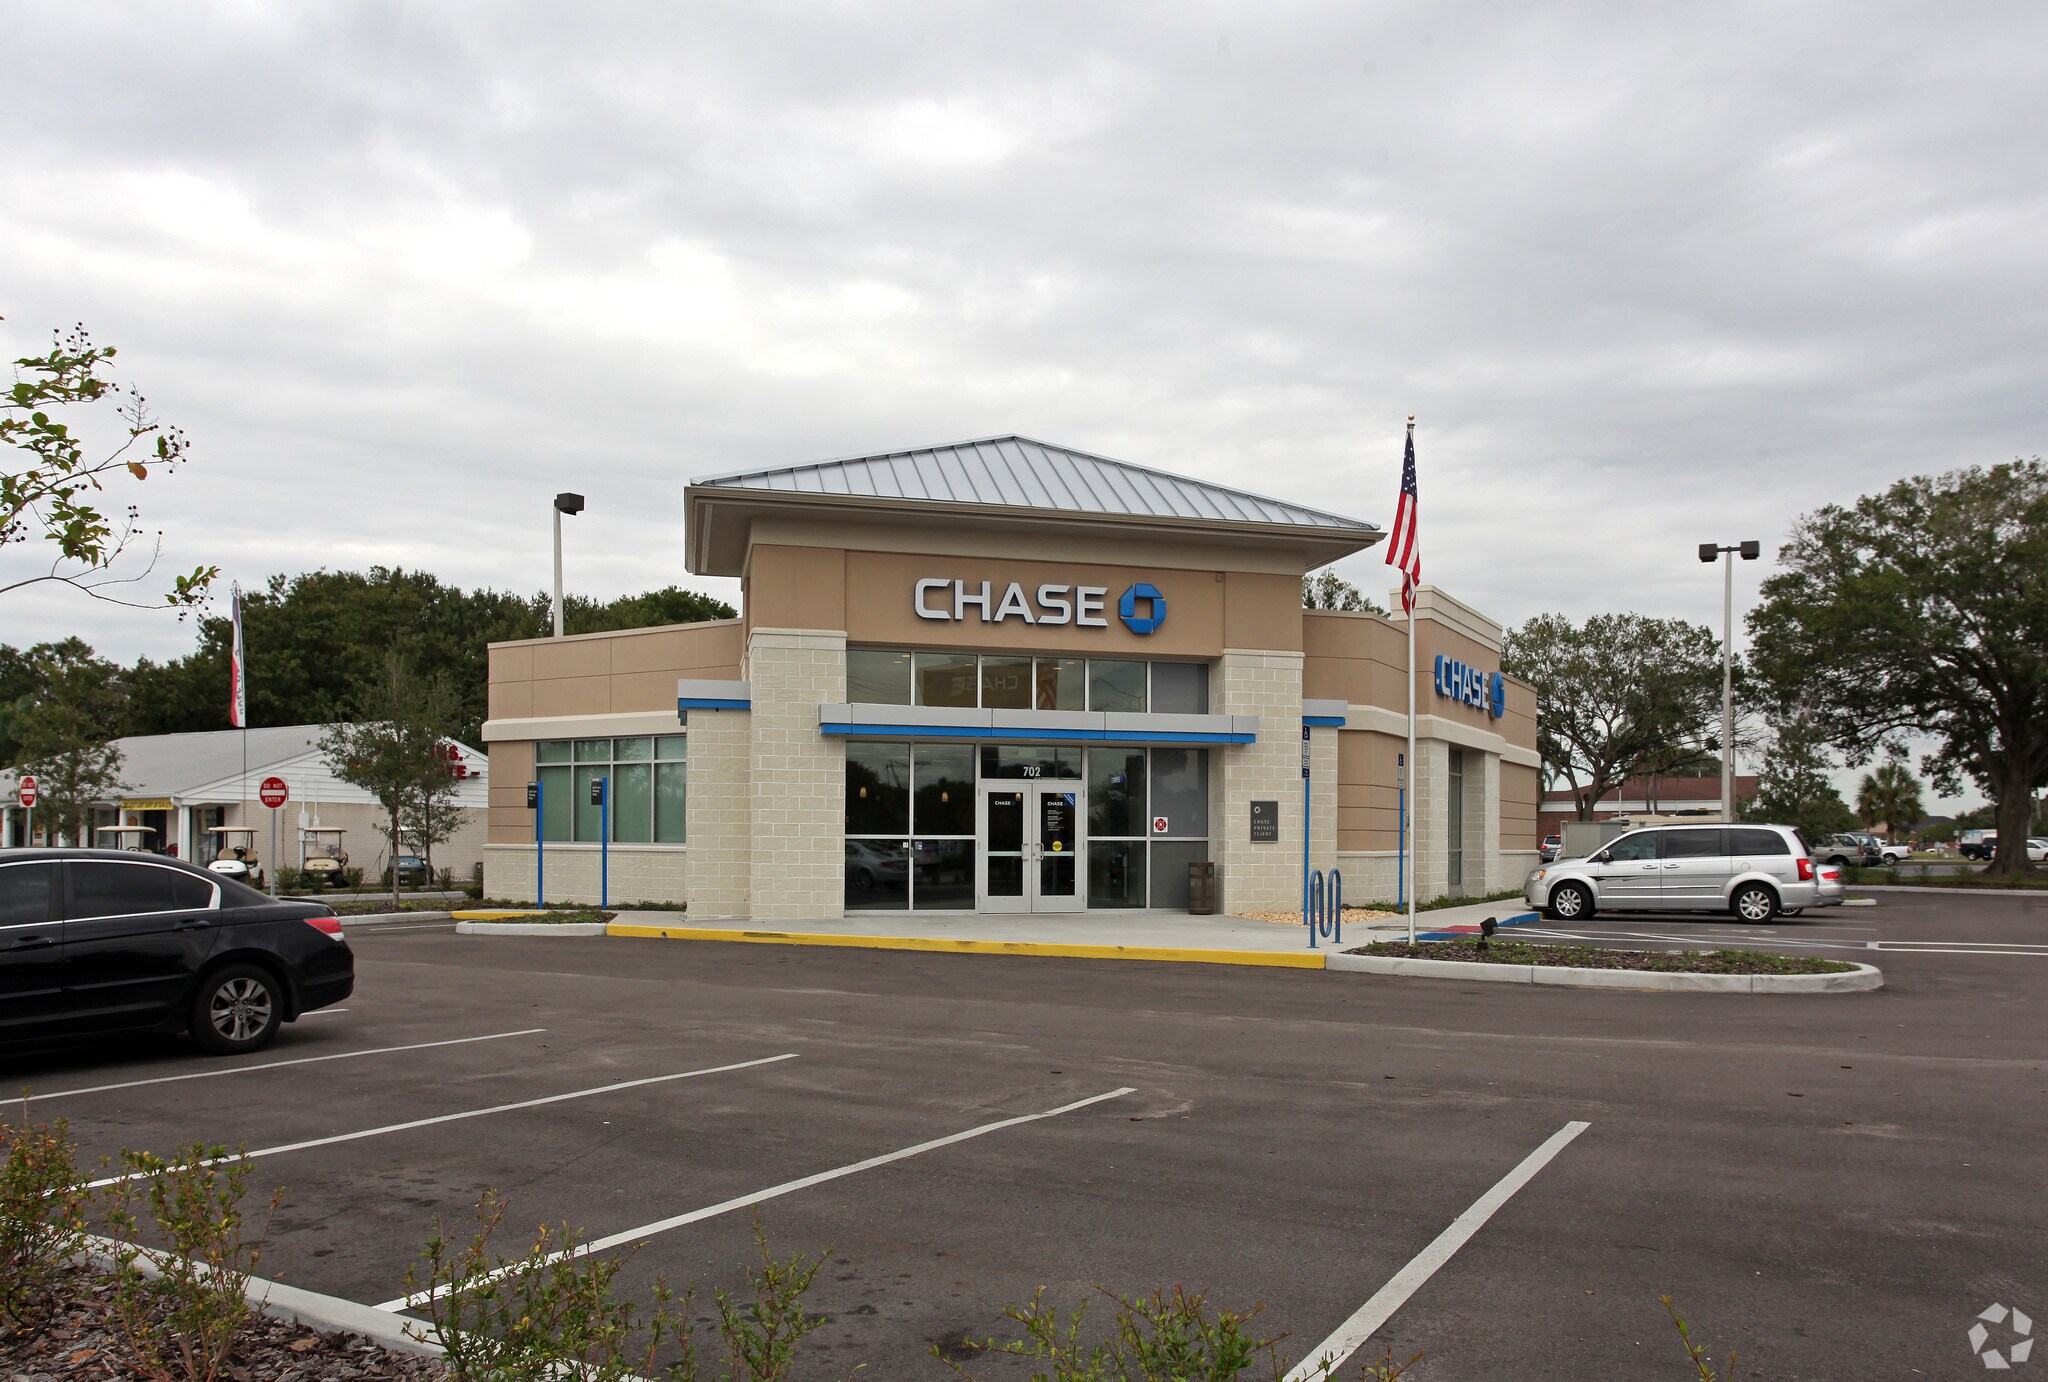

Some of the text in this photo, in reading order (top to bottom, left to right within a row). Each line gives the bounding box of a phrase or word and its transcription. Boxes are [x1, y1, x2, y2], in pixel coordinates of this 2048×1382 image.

[914, 578, 1108, 626] CHASE
[1437, 655, 1490, 710] CHASE
[1023, 766, 1041, 777] 702
